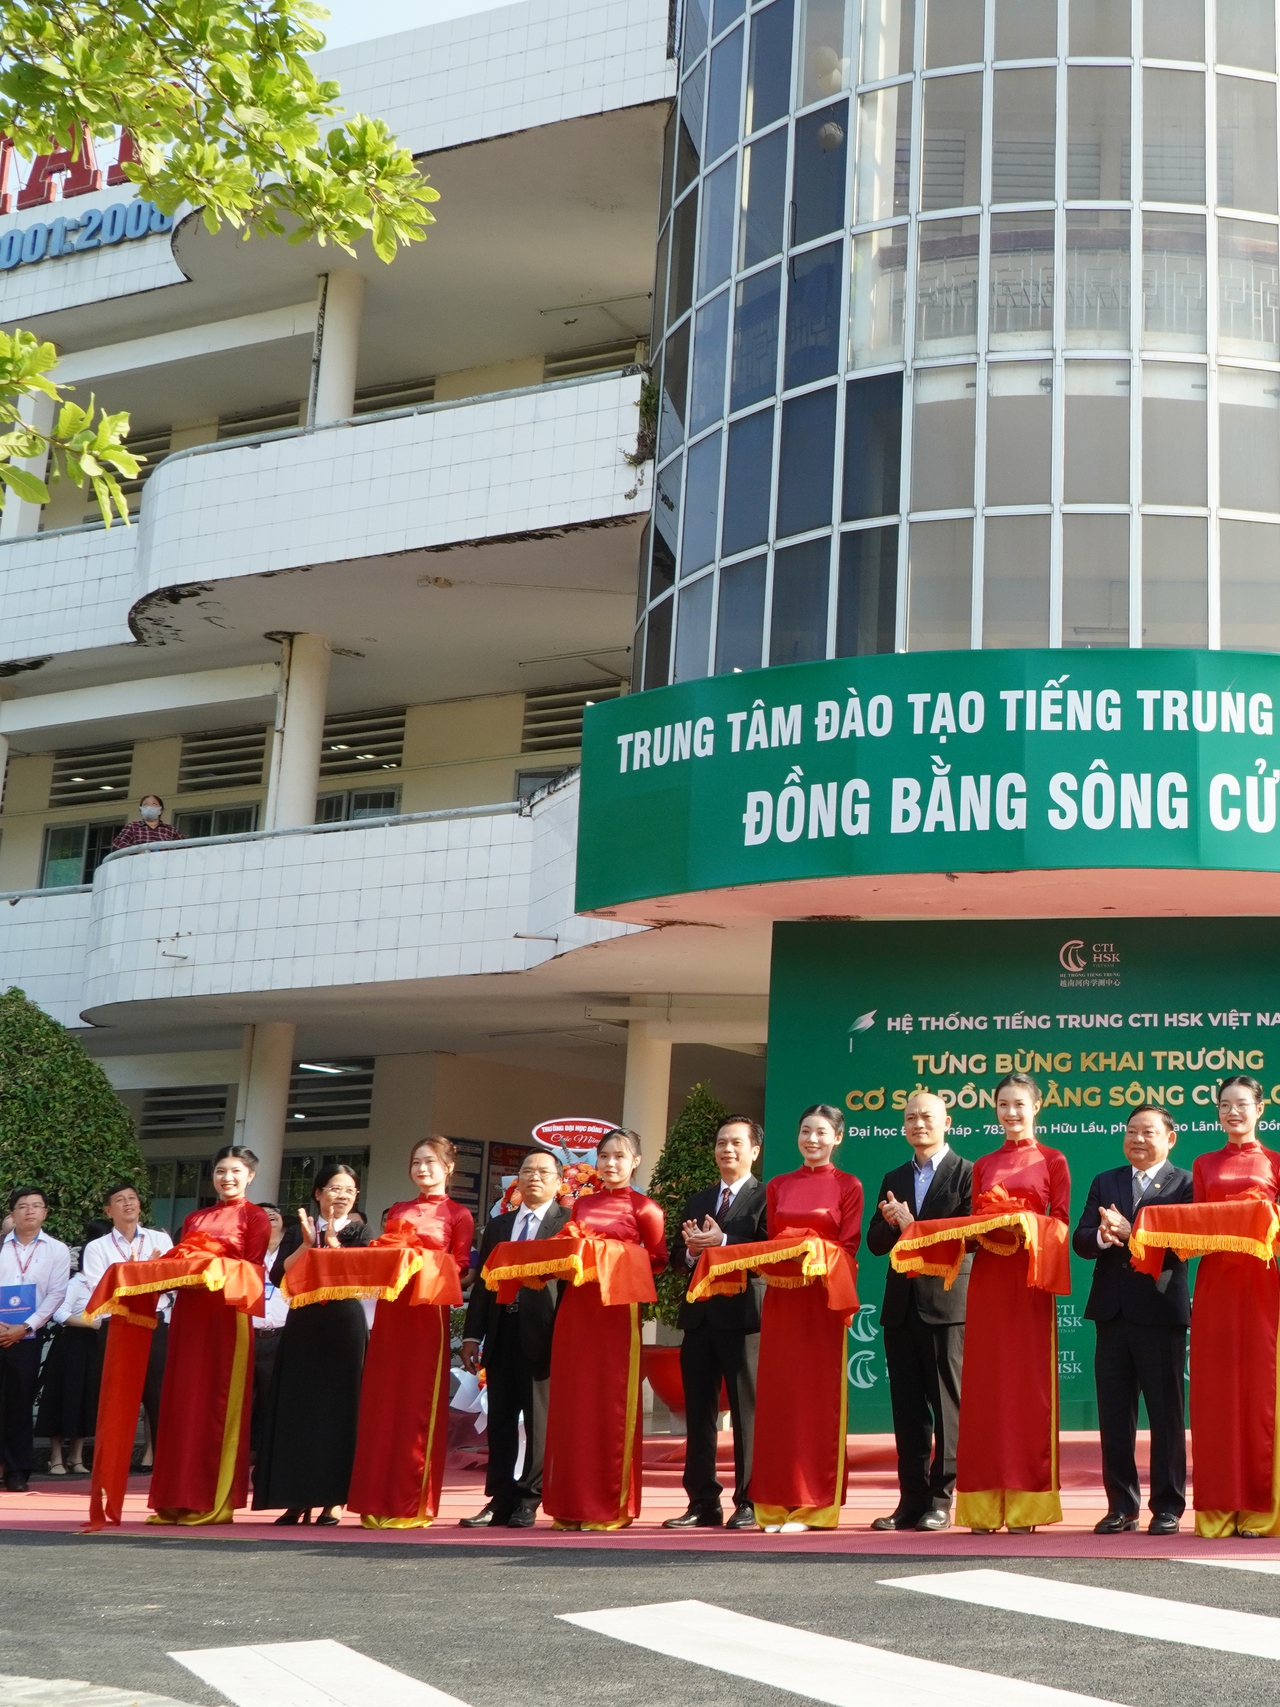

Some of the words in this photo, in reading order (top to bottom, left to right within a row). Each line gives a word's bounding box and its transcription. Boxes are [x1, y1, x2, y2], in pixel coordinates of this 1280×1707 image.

[617, 716, 714, 773] TRUNG
[727, 699, 802, 753] TÂM
[815, 687, 894, 742] ĐÀO
[908, 690, 985, 744] TẠO
[1000, 674, 1122, 732] TIẾNG
[1137, 689, 1273, 736] TRUNG
[742, 765, 870, 846] ĐỒNG
[891, 755, 1027, 834] BẰNG
[1048, 758, 1189, 831] SÔNG
[1092, 943, 1114, 953] CTI
[1093, 953, 1120, 963] HSK
[887, 1014, 913, 1034] HỆ
[919, 1011, 988, 1031] THỐNG
[993, 1010, 1050, 1031] TIẾNG
[1056, 1013, 1122, 1029] TRUNG
[1128, 1012, 1158, 1027] CTI
[1164, 1012, 1203, 1027] HSK
[1208, 1009, 1251, 1030] VIỆT
[912, 1051, 987, 1075] TƯNG
[995, 1048, 1072, 1074] BỪNG
[1080, 1052, 1144, 1072] KHAI
[1151, 1047, 1264, 1072] TRƯƠNG
[845, 1086, 885, 1111] CƠ
[937, 1082, 996, 1109] ĐỒN
[1039, 1079, 1102, 1107] ẰNG
[1109, 1081, 1184, 1107] SÔNG
[848, 1126, 870, 1138] Đại
[874, 1126, 898, 1138] học
[948, 1125, 972, 1137] háp
[983, 1125, 1005, 1135] 783
[1051, 1122, 1077, 1134] Hữu
[1173, 1123, 1188, 1131] ao
[1058, 1350, 1075, 1361] TI
